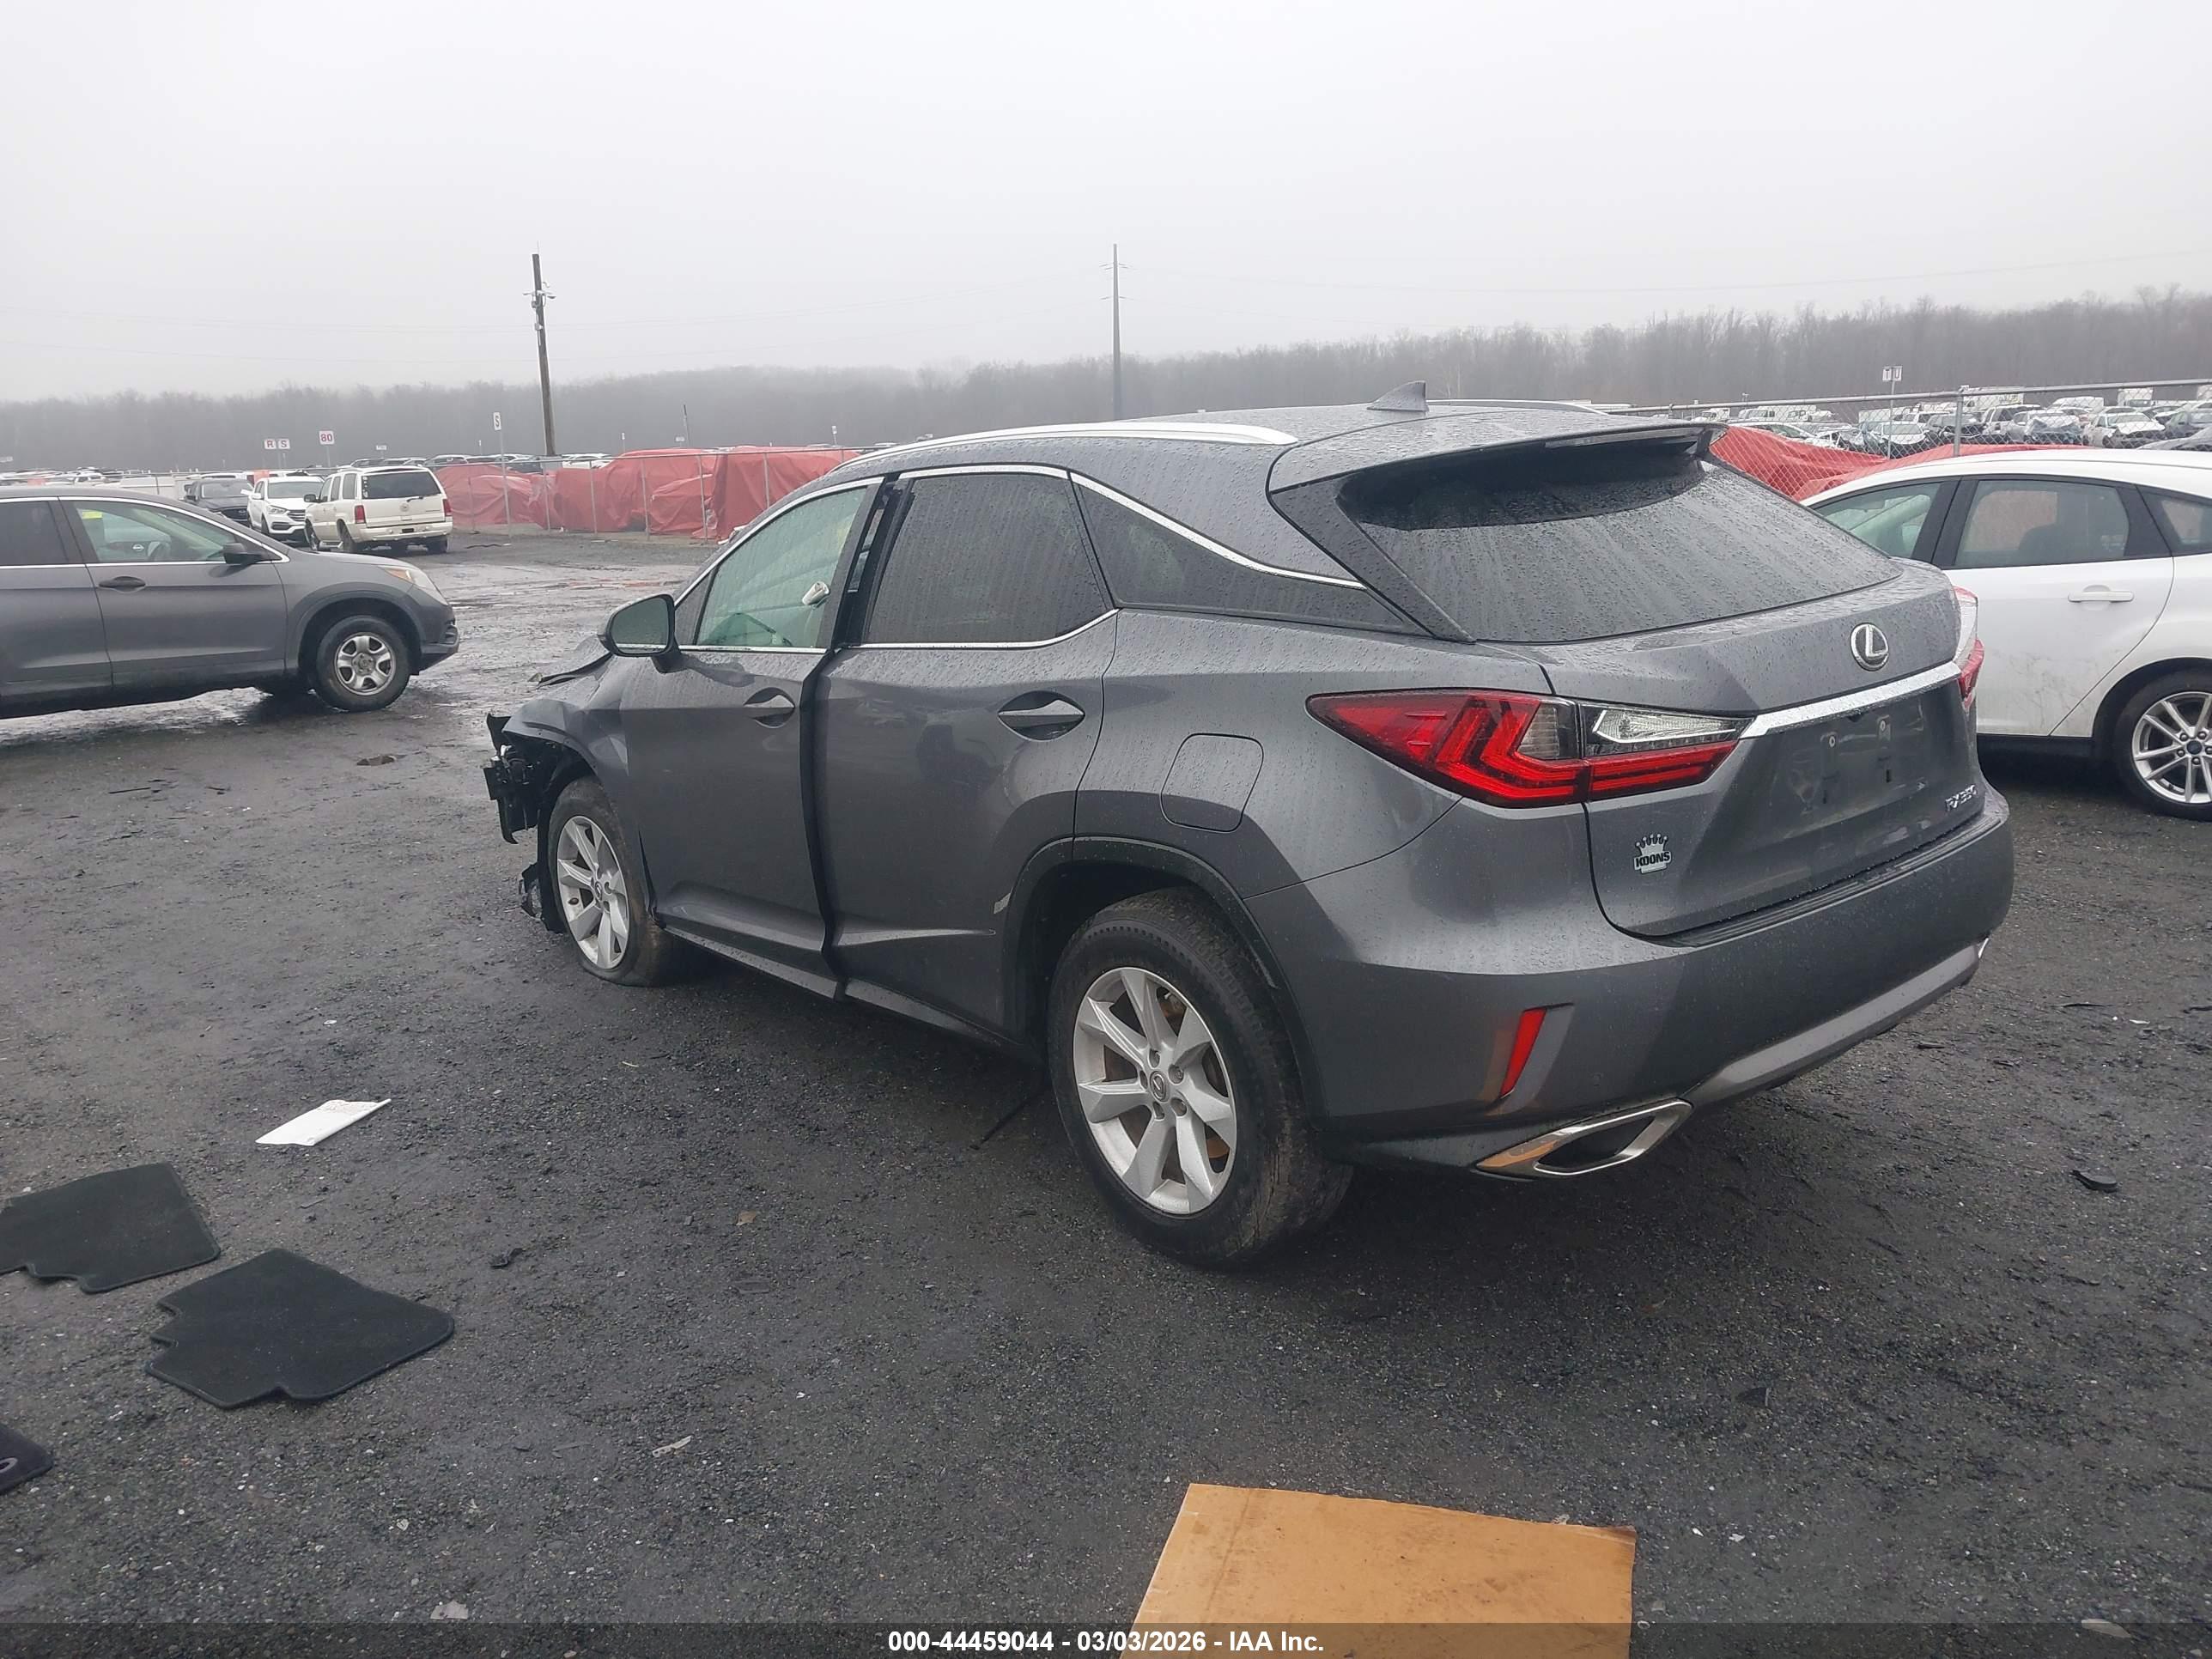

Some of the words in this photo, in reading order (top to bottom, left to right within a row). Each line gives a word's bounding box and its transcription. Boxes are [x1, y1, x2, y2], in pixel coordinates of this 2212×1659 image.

[320, 434, 333, 442] 80
[267, 440, 274, 448] R
[281, 440, 288, 448] S
[1635, 851, 1671, 867] KOONS
